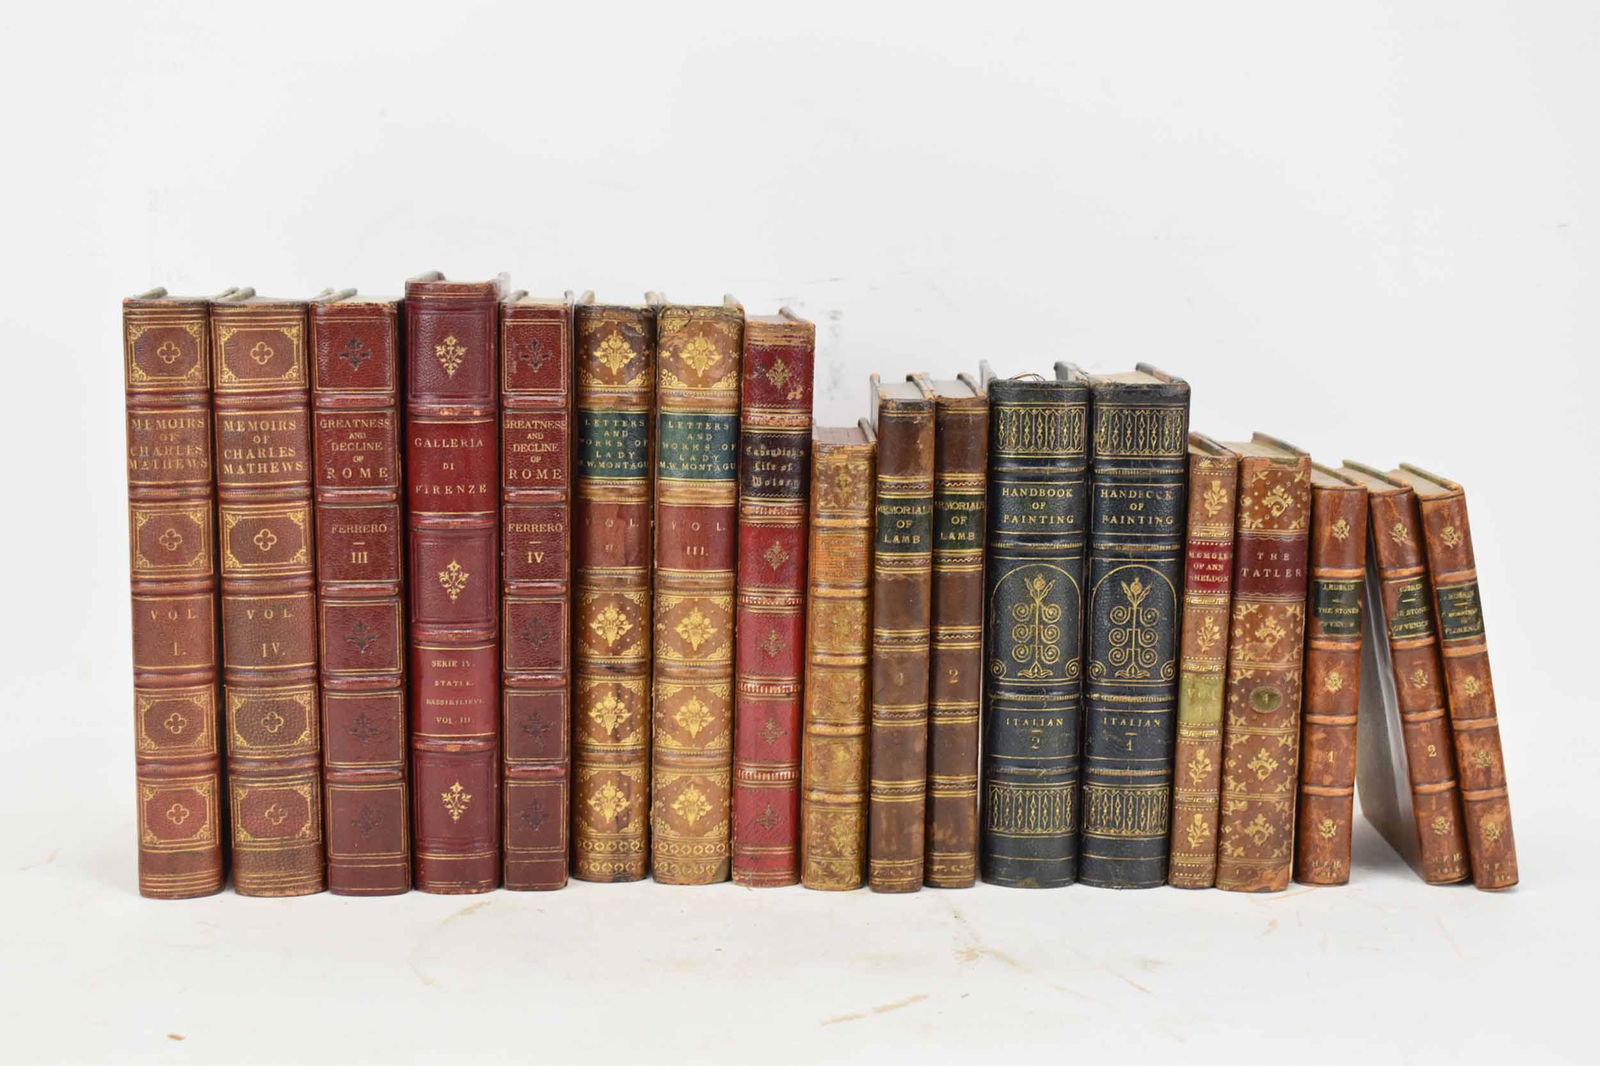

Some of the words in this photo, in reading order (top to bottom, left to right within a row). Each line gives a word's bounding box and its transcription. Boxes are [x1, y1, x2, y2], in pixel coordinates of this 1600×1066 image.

[132, 418, 205, 429] MEMOIRS
[224, 420, 297, 431] MEMOIRS
[320, 419, 390, 429] GREATNESS
[503, 420, 567, 430] GREATNESS
[585, 419, 645, 428] LETTERS
[668, 420, 729, 430] LETTERS
[604, 430, 629, 438] AND
[687, 432, 713, 441] AND
[253, 435, 270, 444] OF
[414, 437, 484, 448] GALLERIA
[580, 439, 623, 447] ORKS
[130, 445, 203, 457] CHARLES
[331, 442, 383, 451] DECLINE
[513, 443, 558, 452] DECLINE
[662, 443, 711, 451] WORKS
[721, 443, 737, 451] OF
[224, 448, 296, 460] CHARLES
[595, 451, 636, 459] LADY
[679, 454, 720, 462] LADY
[129, 459, 208, 470] MATHEWS
[223, 461, 304, 474] MATHEWS
[443, 462, 455, 470] DI
[682, 462, 737, 472] MONTAGU
[755, 461, 776, 471] Life
[781, 463, 793, 471] of
[326, 467, 388, 479] ROME
[509, 468, 562, 480] ROME
[415, 484, 487, 494] FIRENZE
[1002, 487, 1073, 497] HANDBOOK
[1032, 502, 1046, 510] OF
[1129, 503, 1144, 511] OF
[896, 520, 912, 528] OF
[951, 516, 967, 525] OF
[1003, 515, 1074, 524] PAINTING
[1102, 515, 1174, 525] PAINTING
[331, 523, 387, 533] FERRERO
[508, 523, 563, 532] FERRERO
[884, 535, 920, 544] LAMB
[941, 531, 975, 540] LAMB
[351, 552, 368, 564] III
[527, 552, 544, 564] IV
[1257, 552, 1290, 561] THE
[1241, 568, 1302, 579] TATLER
[949, 668, 959, 684] 2
[1006, 717, 1064, 726] ITALIAN
[1103, 717, 1161, 727] ITALIAN
[1031, 737, 1040, 750] 2
[1126, 739, 1133, 751] 1
[1427, 744, 1437, 758] 2
